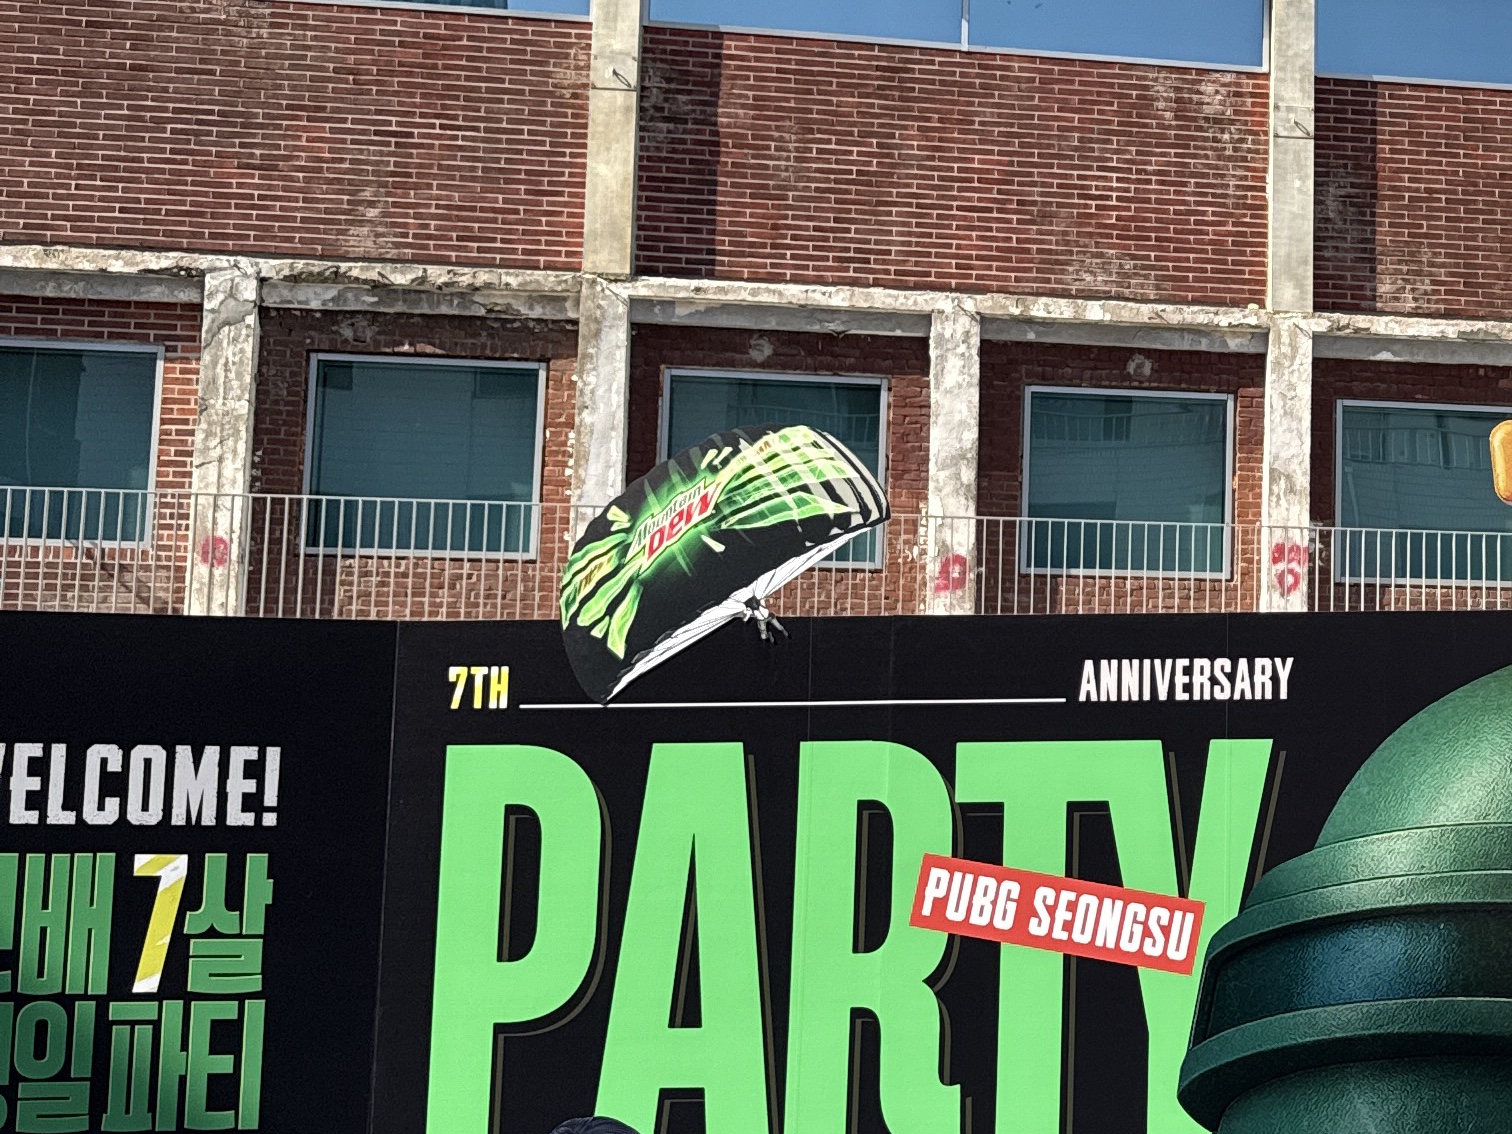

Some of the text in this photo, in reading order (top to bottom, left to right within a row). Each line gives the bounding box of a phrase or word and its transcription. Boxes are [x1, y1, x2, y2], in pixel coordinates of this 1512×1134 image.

[448, 656, 1295, 709] 7TH ANNIVERSARY
[0, 742, 282, 827] ELCOME!
[921, 866, 1195, 962] PUBG SEONGSU
